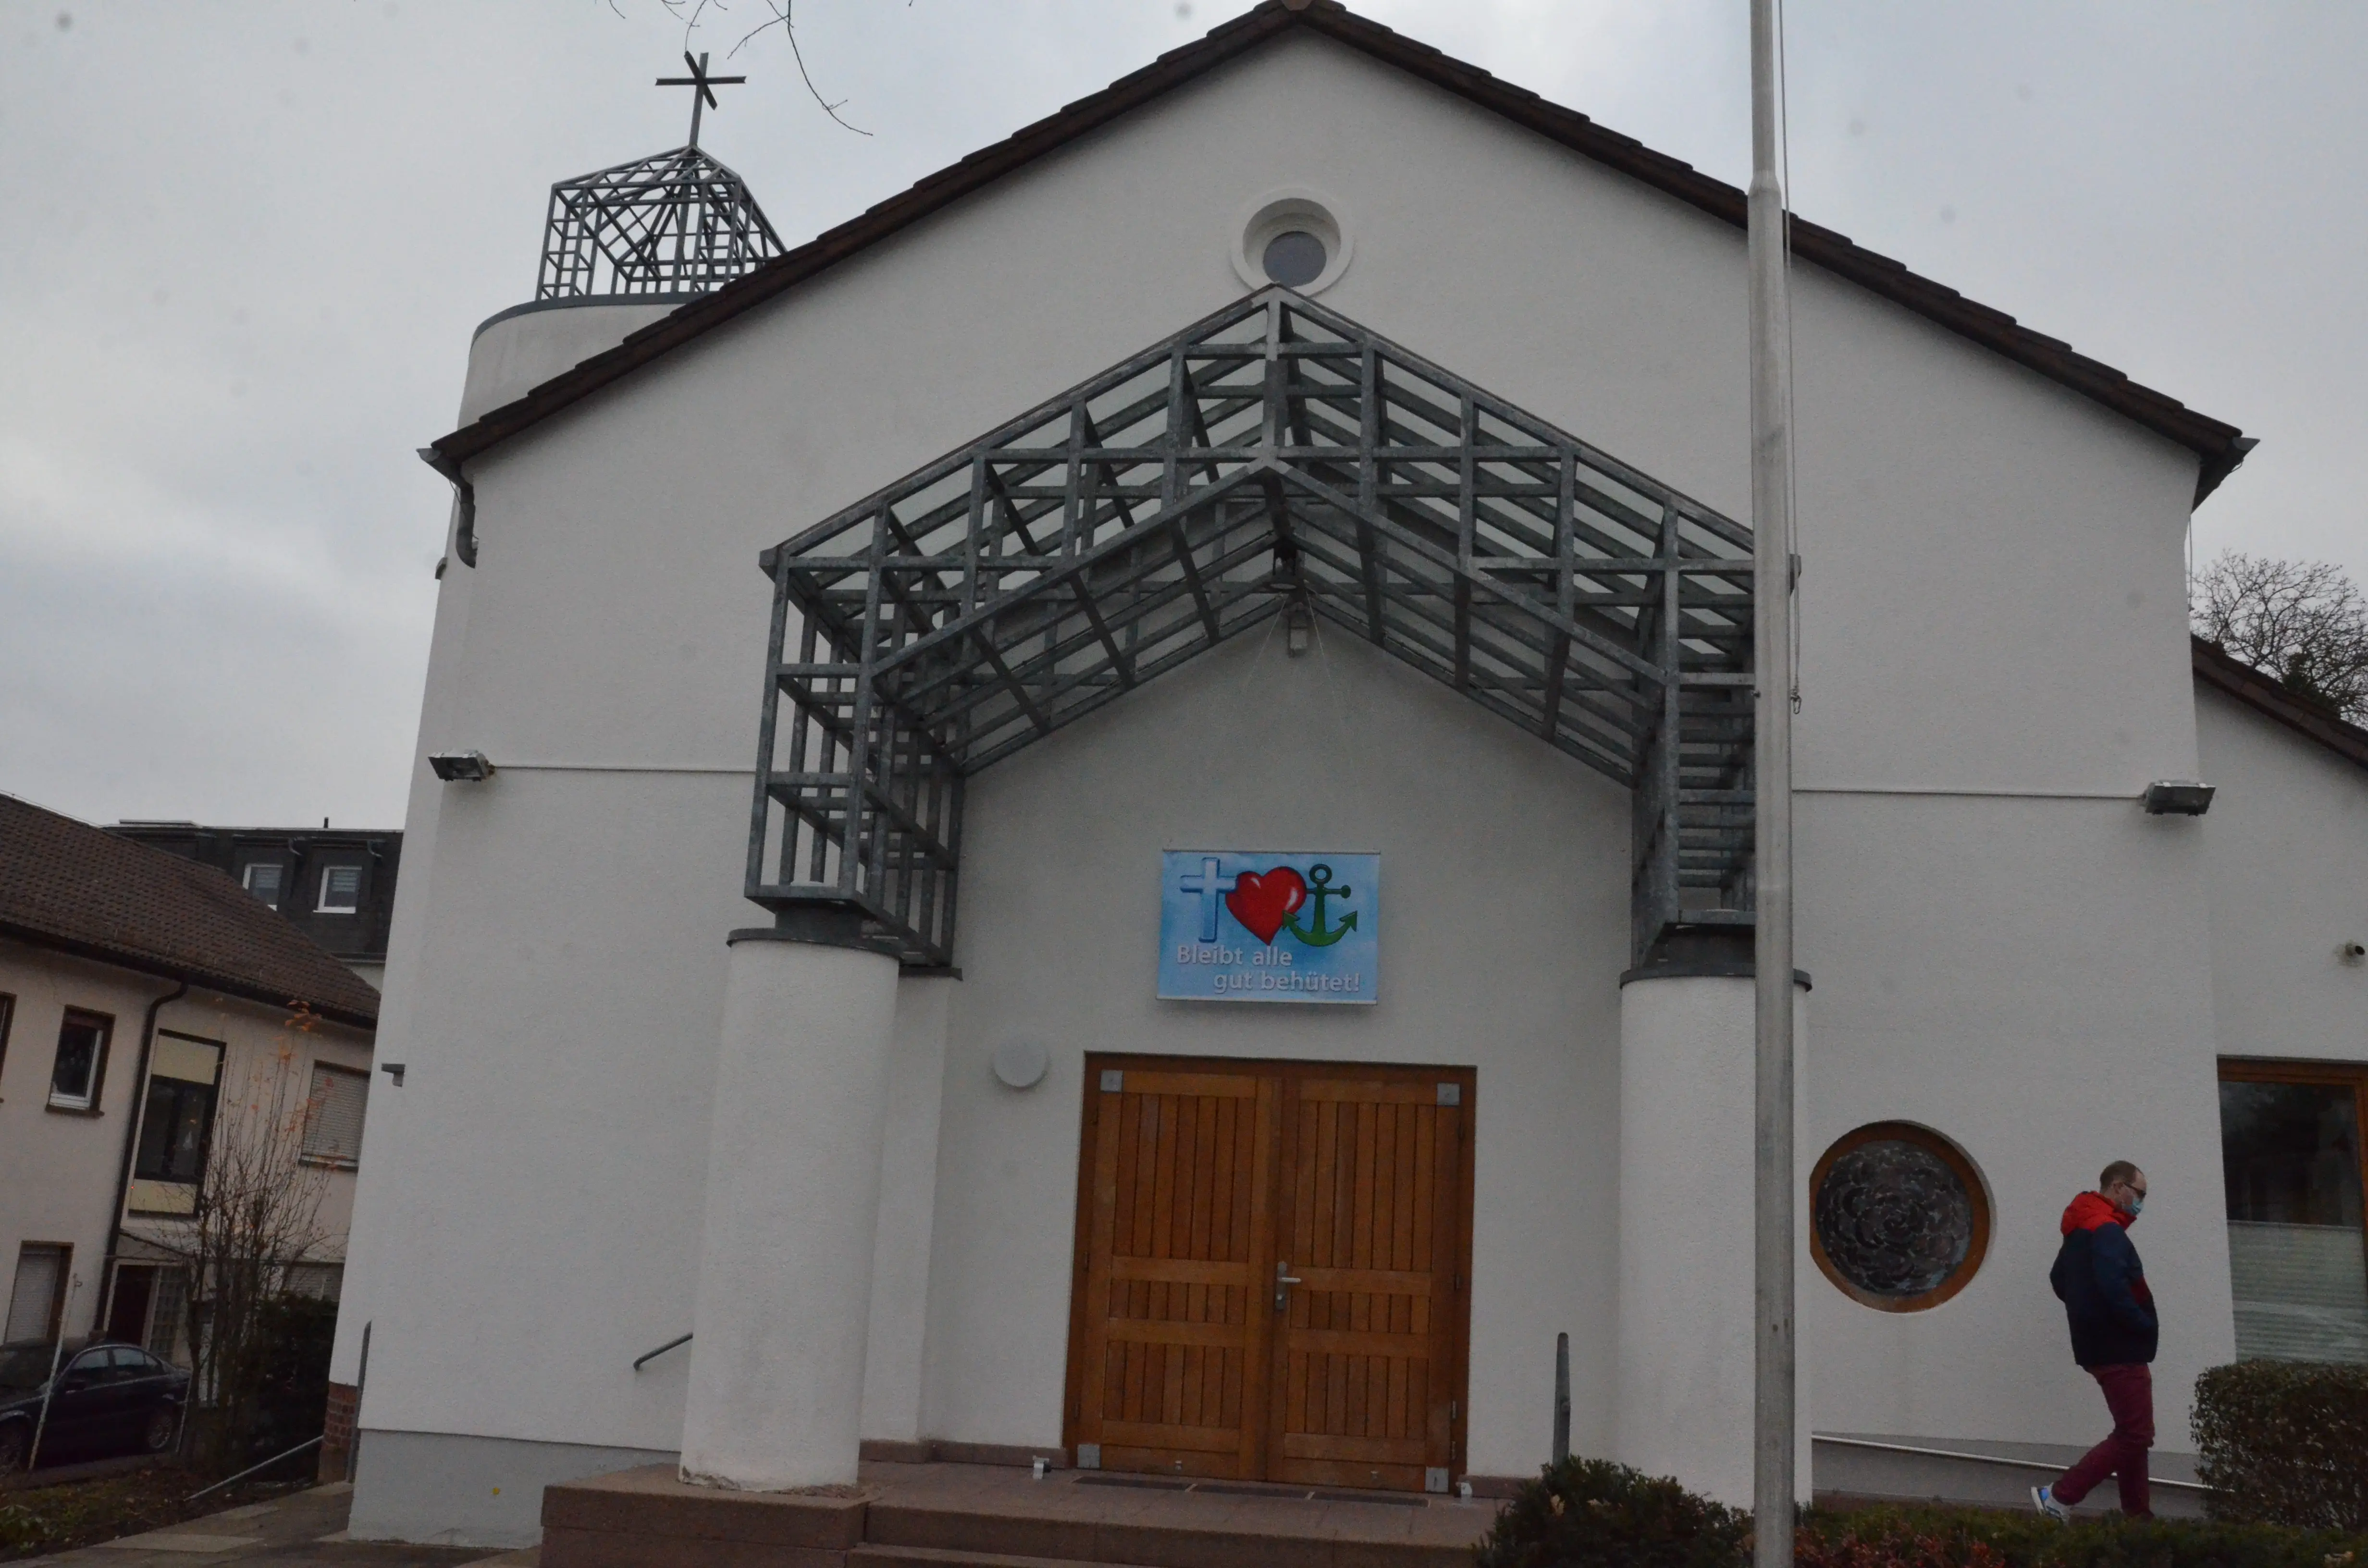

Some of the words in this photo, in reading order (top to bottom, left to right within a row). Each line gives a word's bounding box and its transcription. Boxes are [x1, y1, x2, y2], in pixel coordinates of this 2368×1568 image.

[1177, 944, 1243, 965] Bleibt
[1252, 946, 1293, 967] alle
[1213, 972, 1253, 993] gut
[1261, 971, 1360, 992] behütet!
